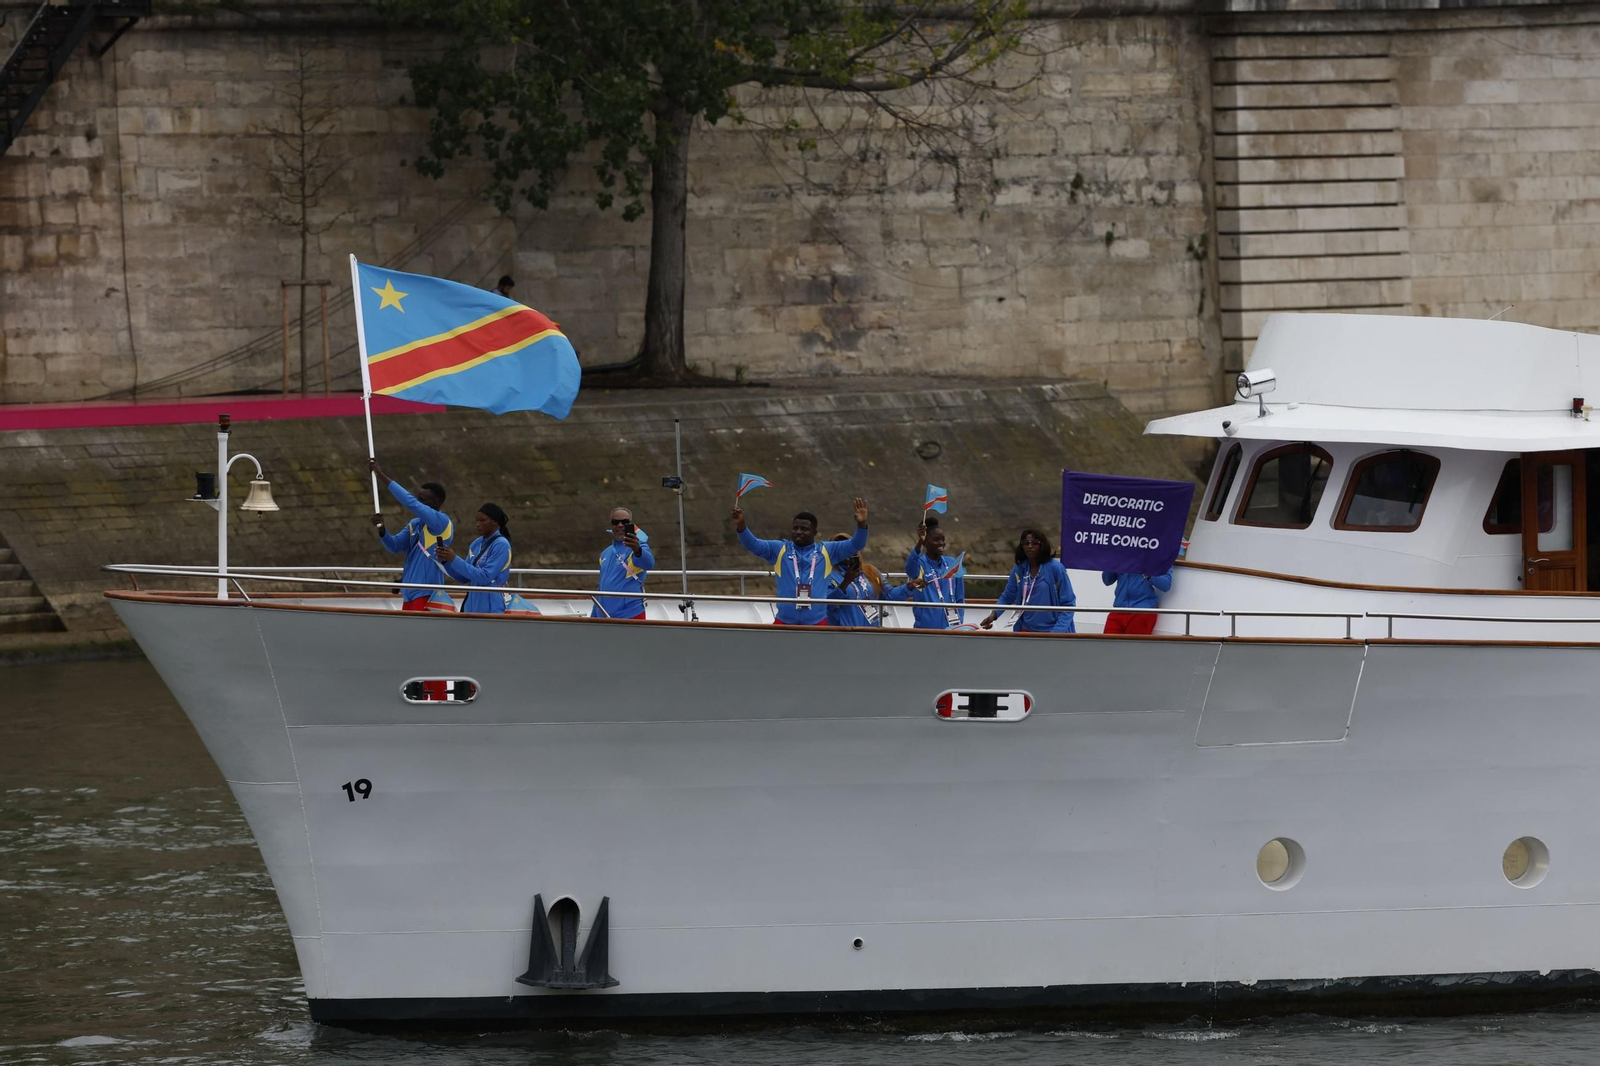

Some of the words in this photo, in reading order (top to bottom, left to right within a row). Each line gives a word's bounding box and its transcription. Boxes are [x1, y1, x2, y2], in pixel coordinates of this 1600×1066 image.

[1083, 493, 1164, 512] DEMOCRATIC
[1090, 513, 1147, 529] REPUBLIC
[1074, 531, 1088, 543] OF
[1090, 532, 1110, 545] THE
[1111, 534, 1160, 550] CONGO
[341, 778, 373, 802] 19
